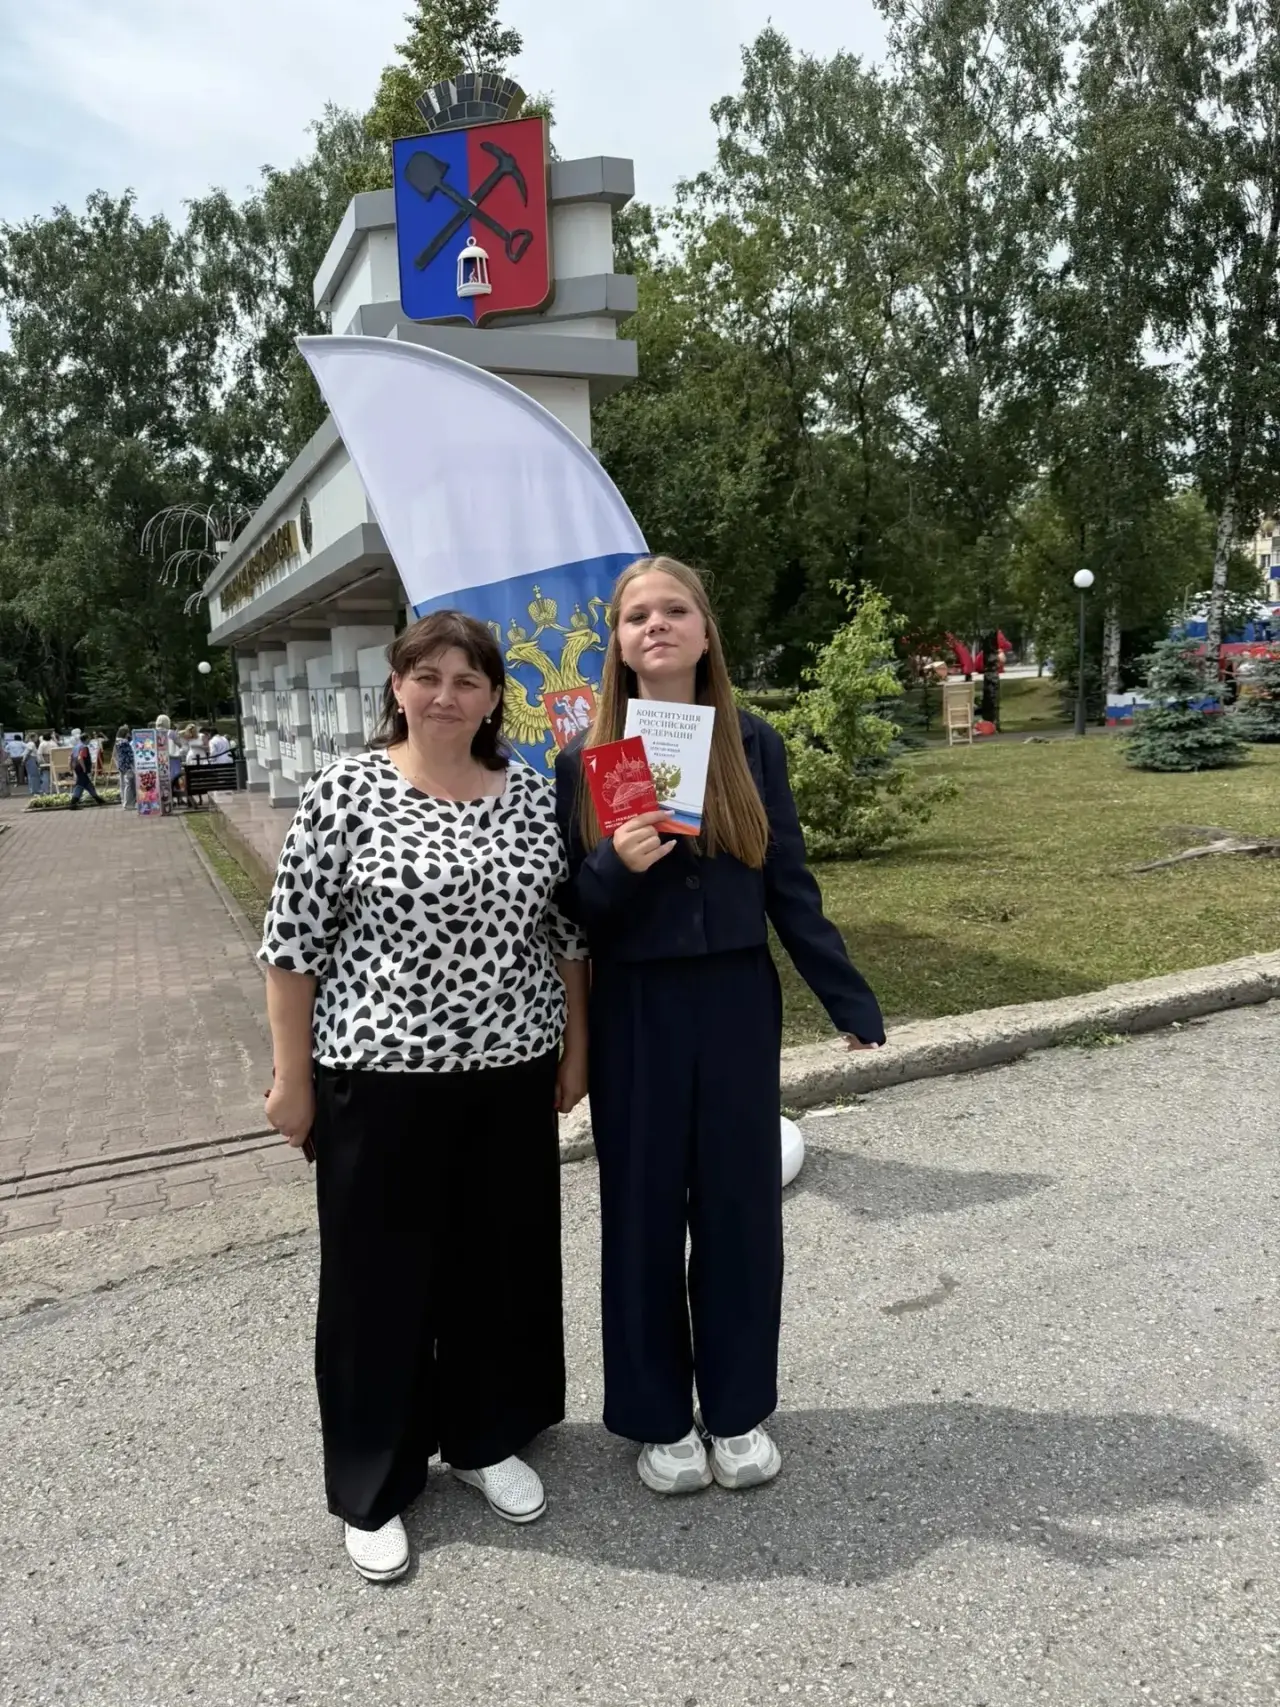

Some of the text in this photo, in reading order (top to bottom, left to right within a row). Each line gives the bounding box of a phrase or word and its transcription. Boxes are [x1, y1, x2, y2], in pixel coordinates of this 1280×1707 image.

[636, 709, 701, 722] КОНСТИТУЦИЯ
[639, 718, 697, 731] РОССИЙСКОЙ
[640, 728, 693, 740] ФЕДЕРАЦИИ
